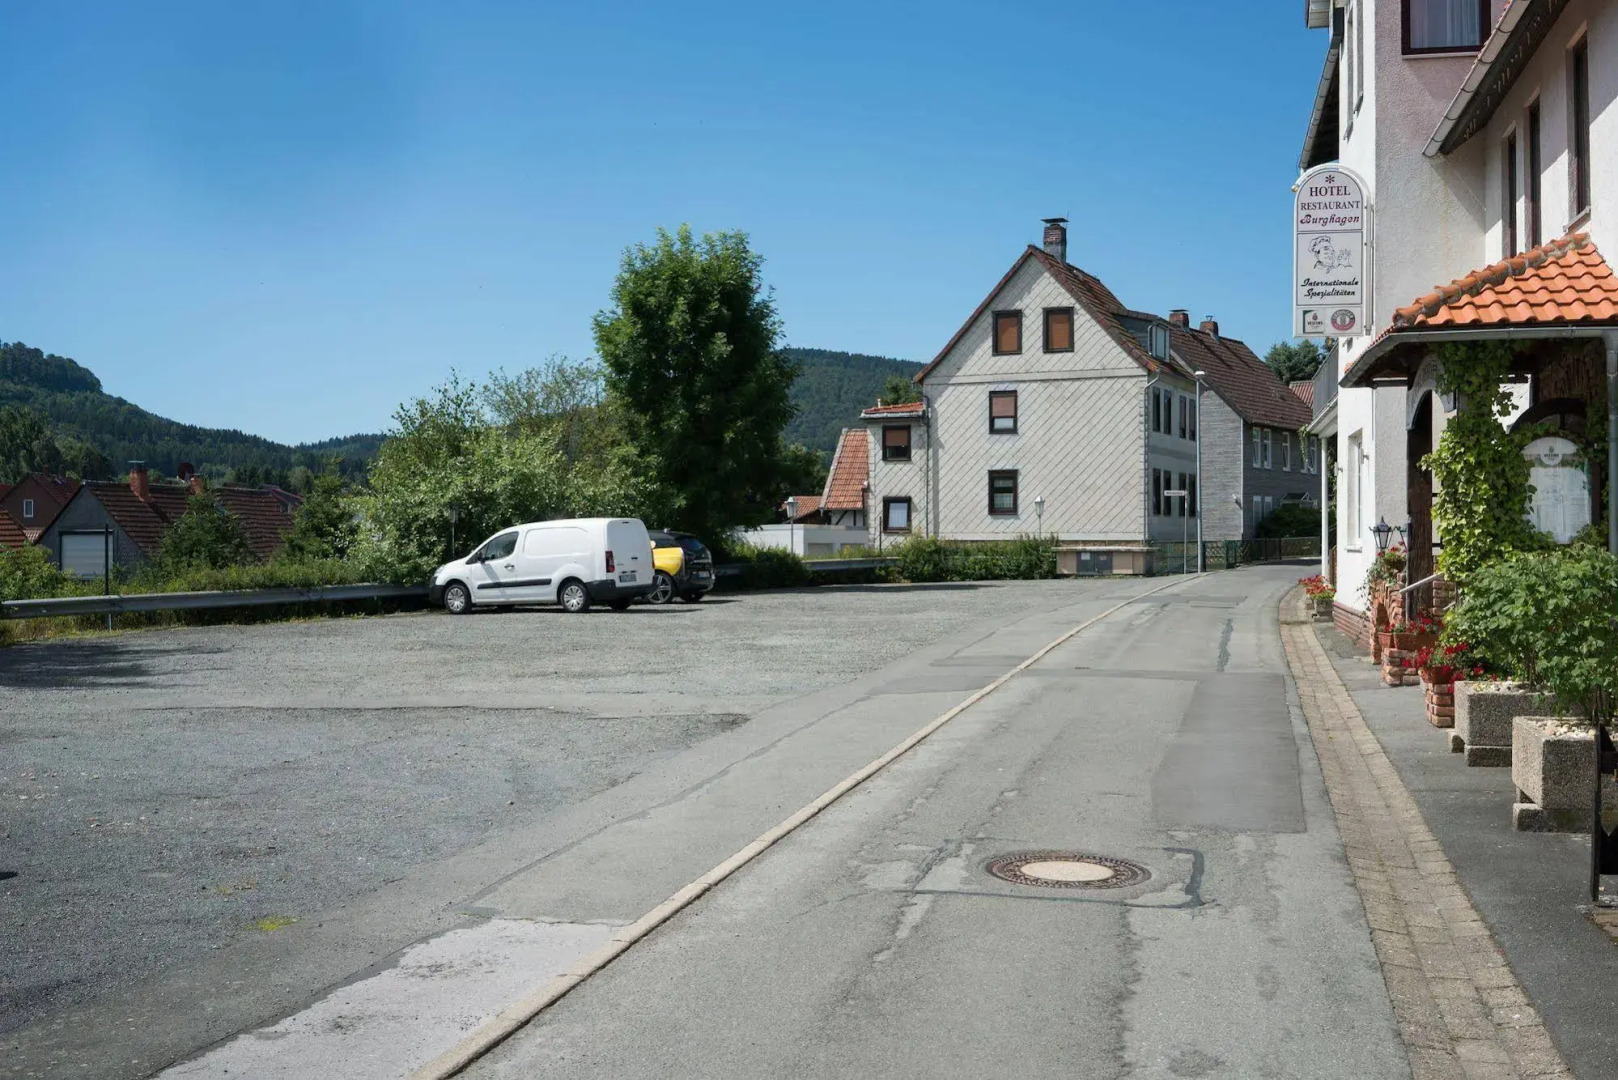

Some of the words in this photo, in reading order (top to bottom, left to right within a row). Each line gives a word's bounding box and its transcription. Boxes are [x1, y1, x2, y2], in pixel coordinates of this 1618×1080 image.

[1309, 186, 1350, 197] HOTEL
[1301, 201, 1360, 211] RESTAURANT
[1300, 214, 1360, 227] Burghagen
[1301, 277, 1359, 287] Internationale
[1304, 288, 1355, 300] Spezialitäten
